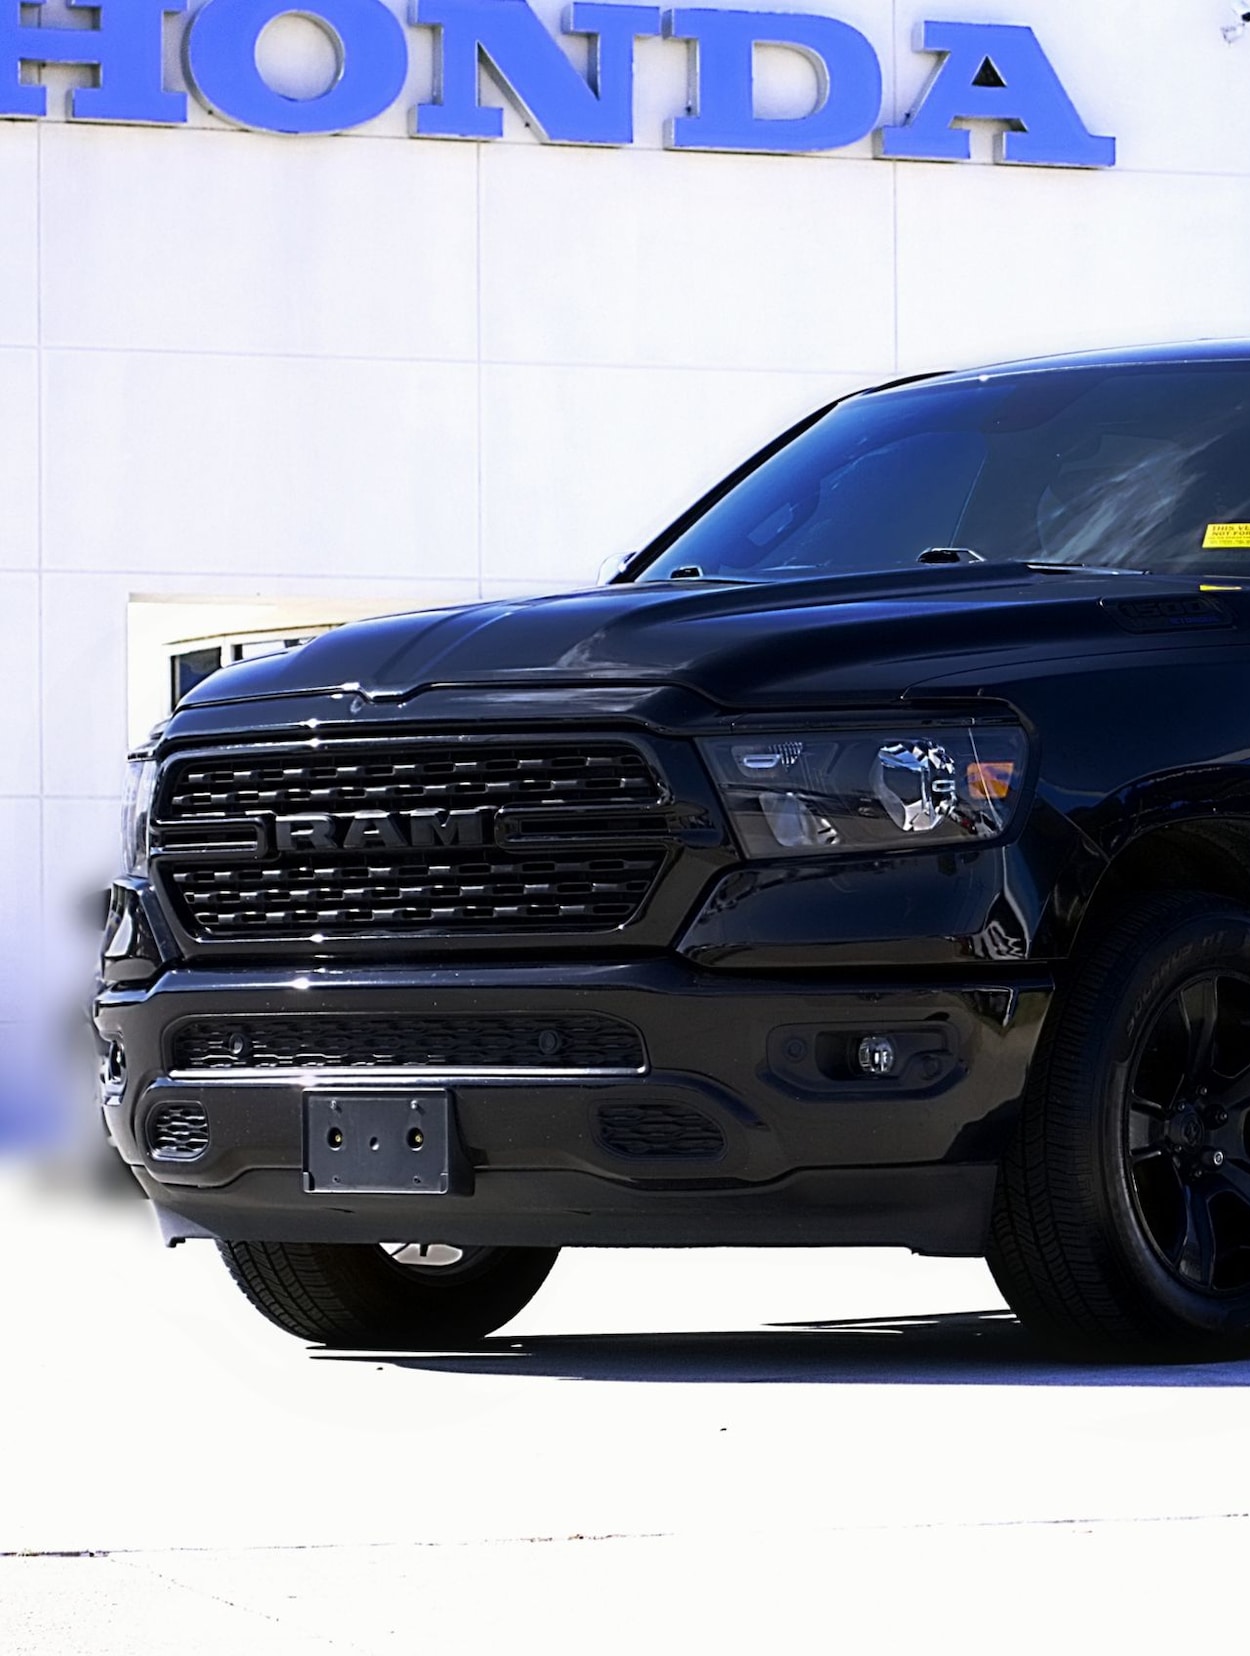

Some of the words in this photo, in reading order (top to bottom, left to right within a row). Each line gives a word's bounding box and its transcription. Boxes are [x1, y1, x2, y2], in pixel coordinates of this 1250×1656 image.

[0, 0, 1116, 168] HONDA
[1118, 600, 1208, 617] 1500
[275, 806, 485, 850] RAM
